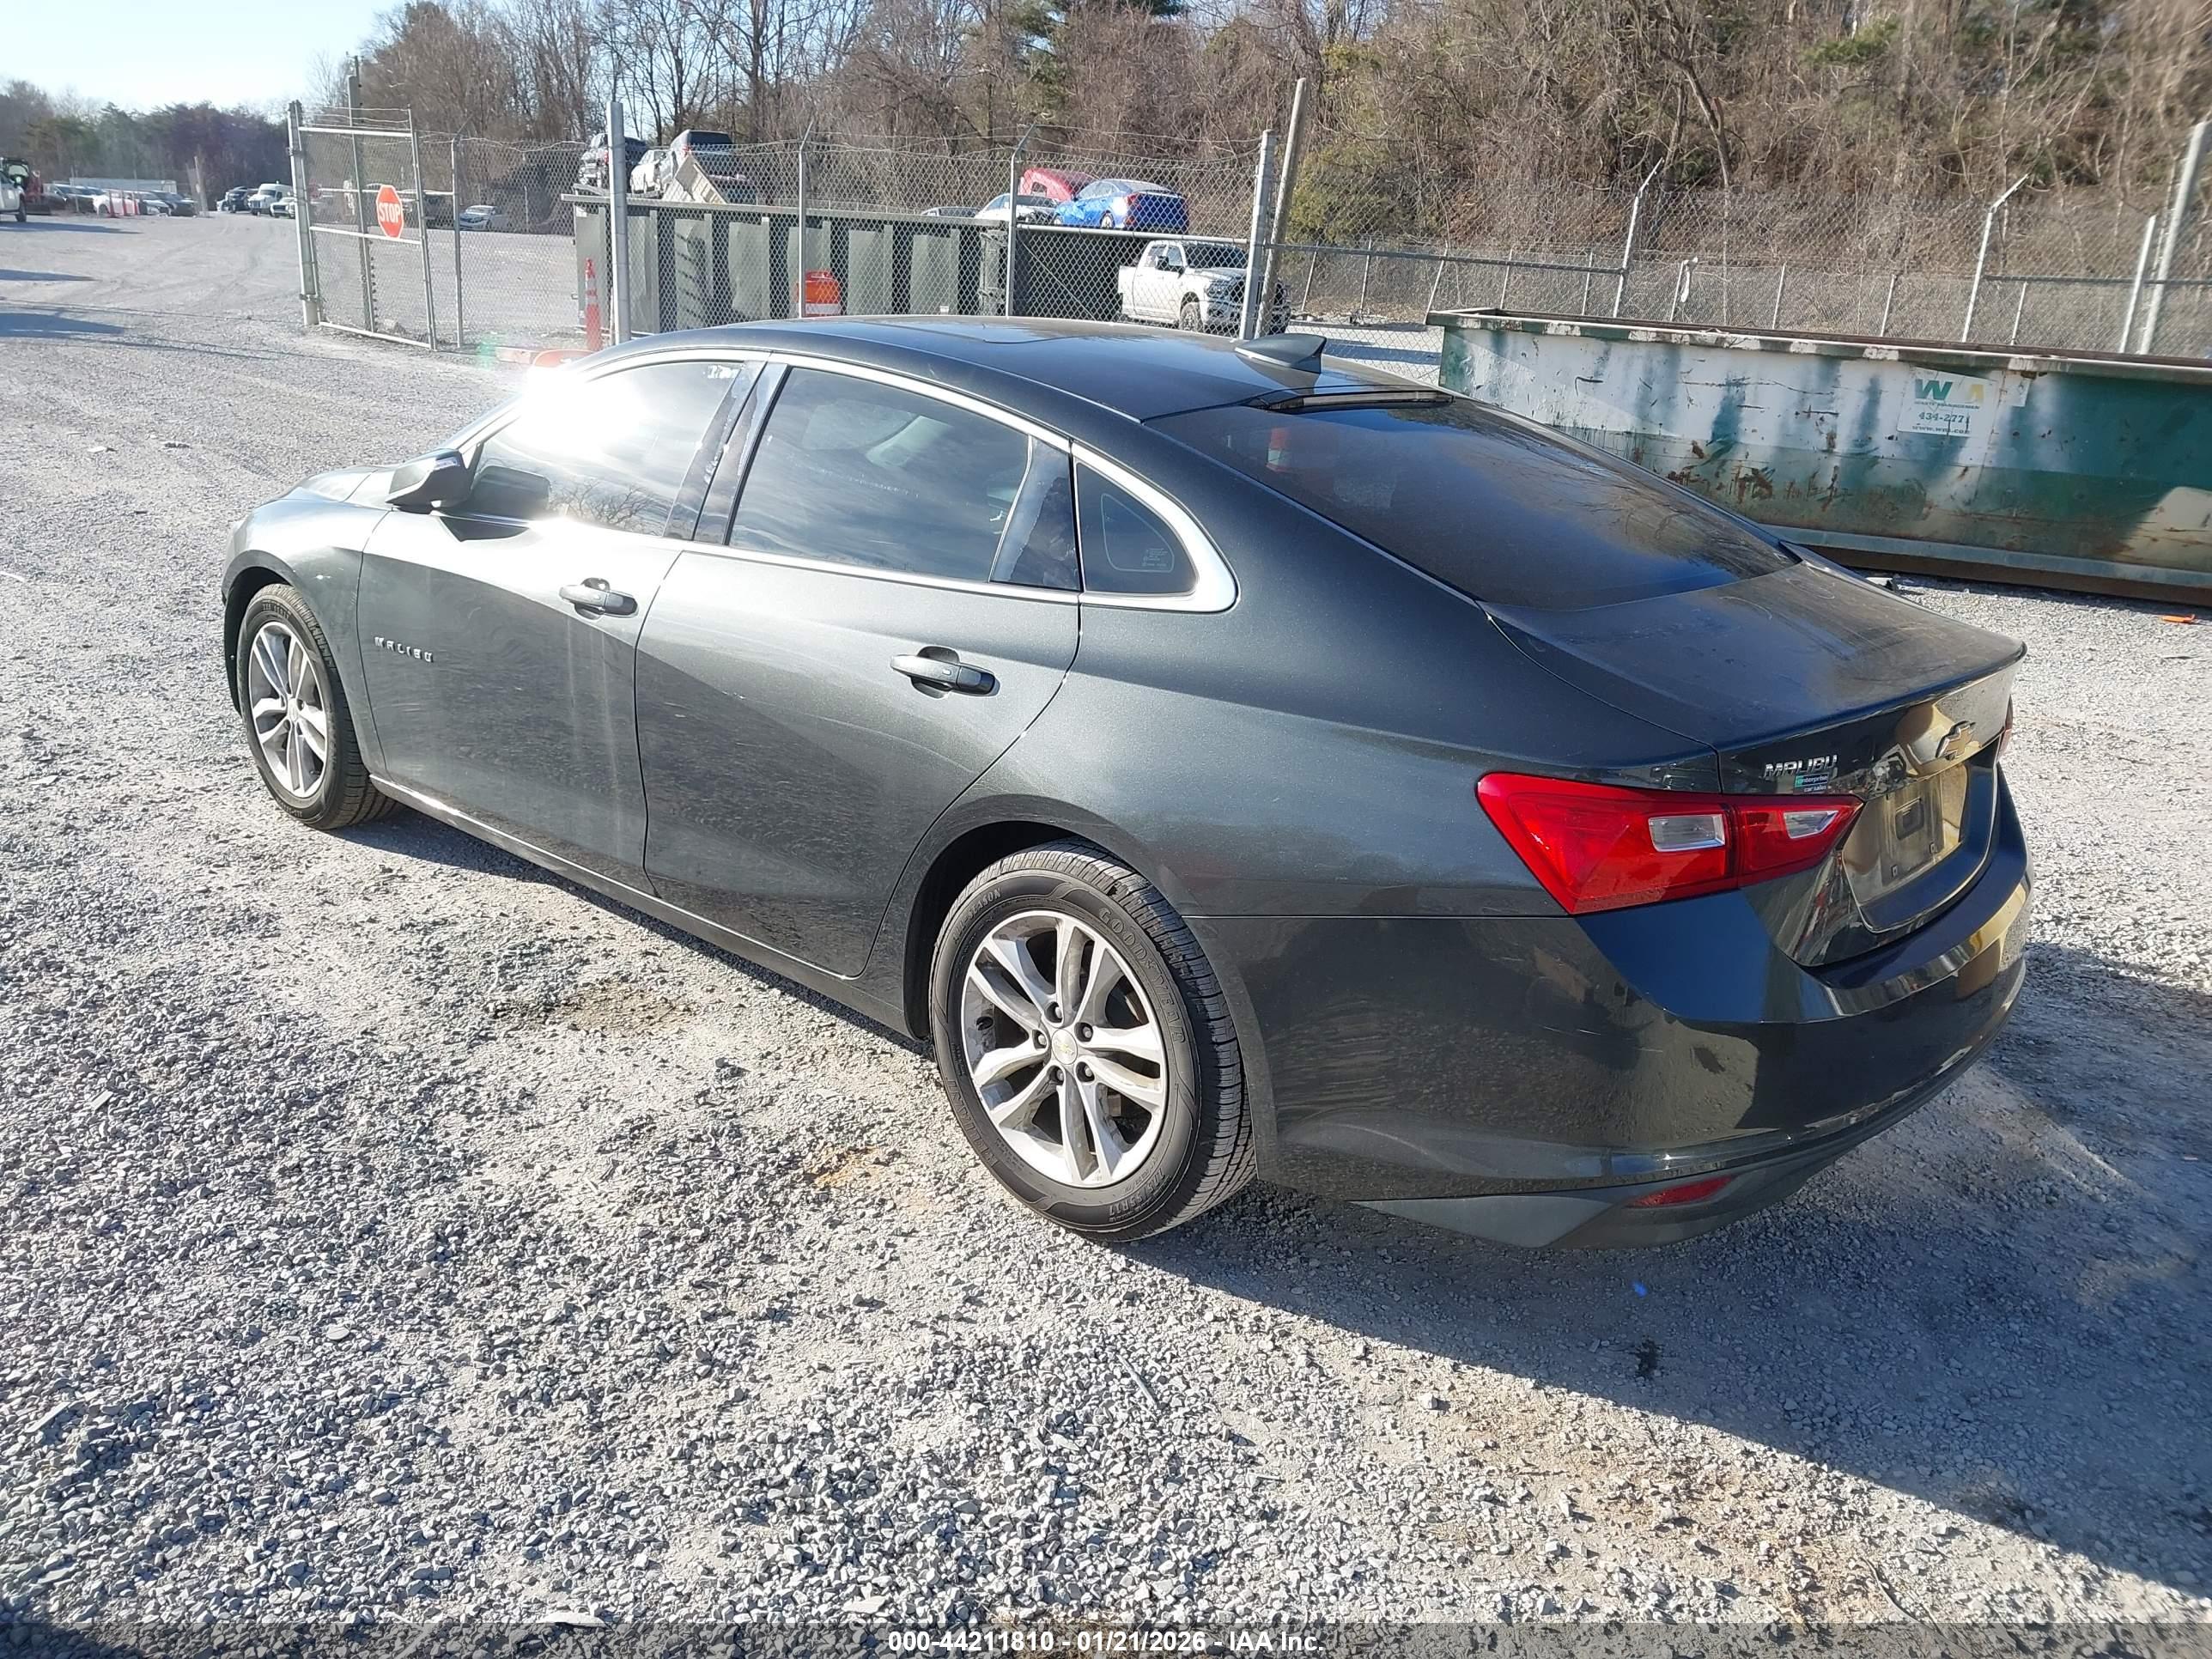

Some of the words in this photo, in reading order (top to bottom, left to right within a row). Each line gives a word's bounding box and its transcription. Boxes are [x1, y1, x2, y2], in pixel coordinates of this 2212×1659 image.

[379, 203, 401, 223] STOP
[374, 636, 433, 663] MALIBU
[1763, 755, 1838, 778] MALIBU
[1099, 907, 1187, 1042] GOODYEAR
